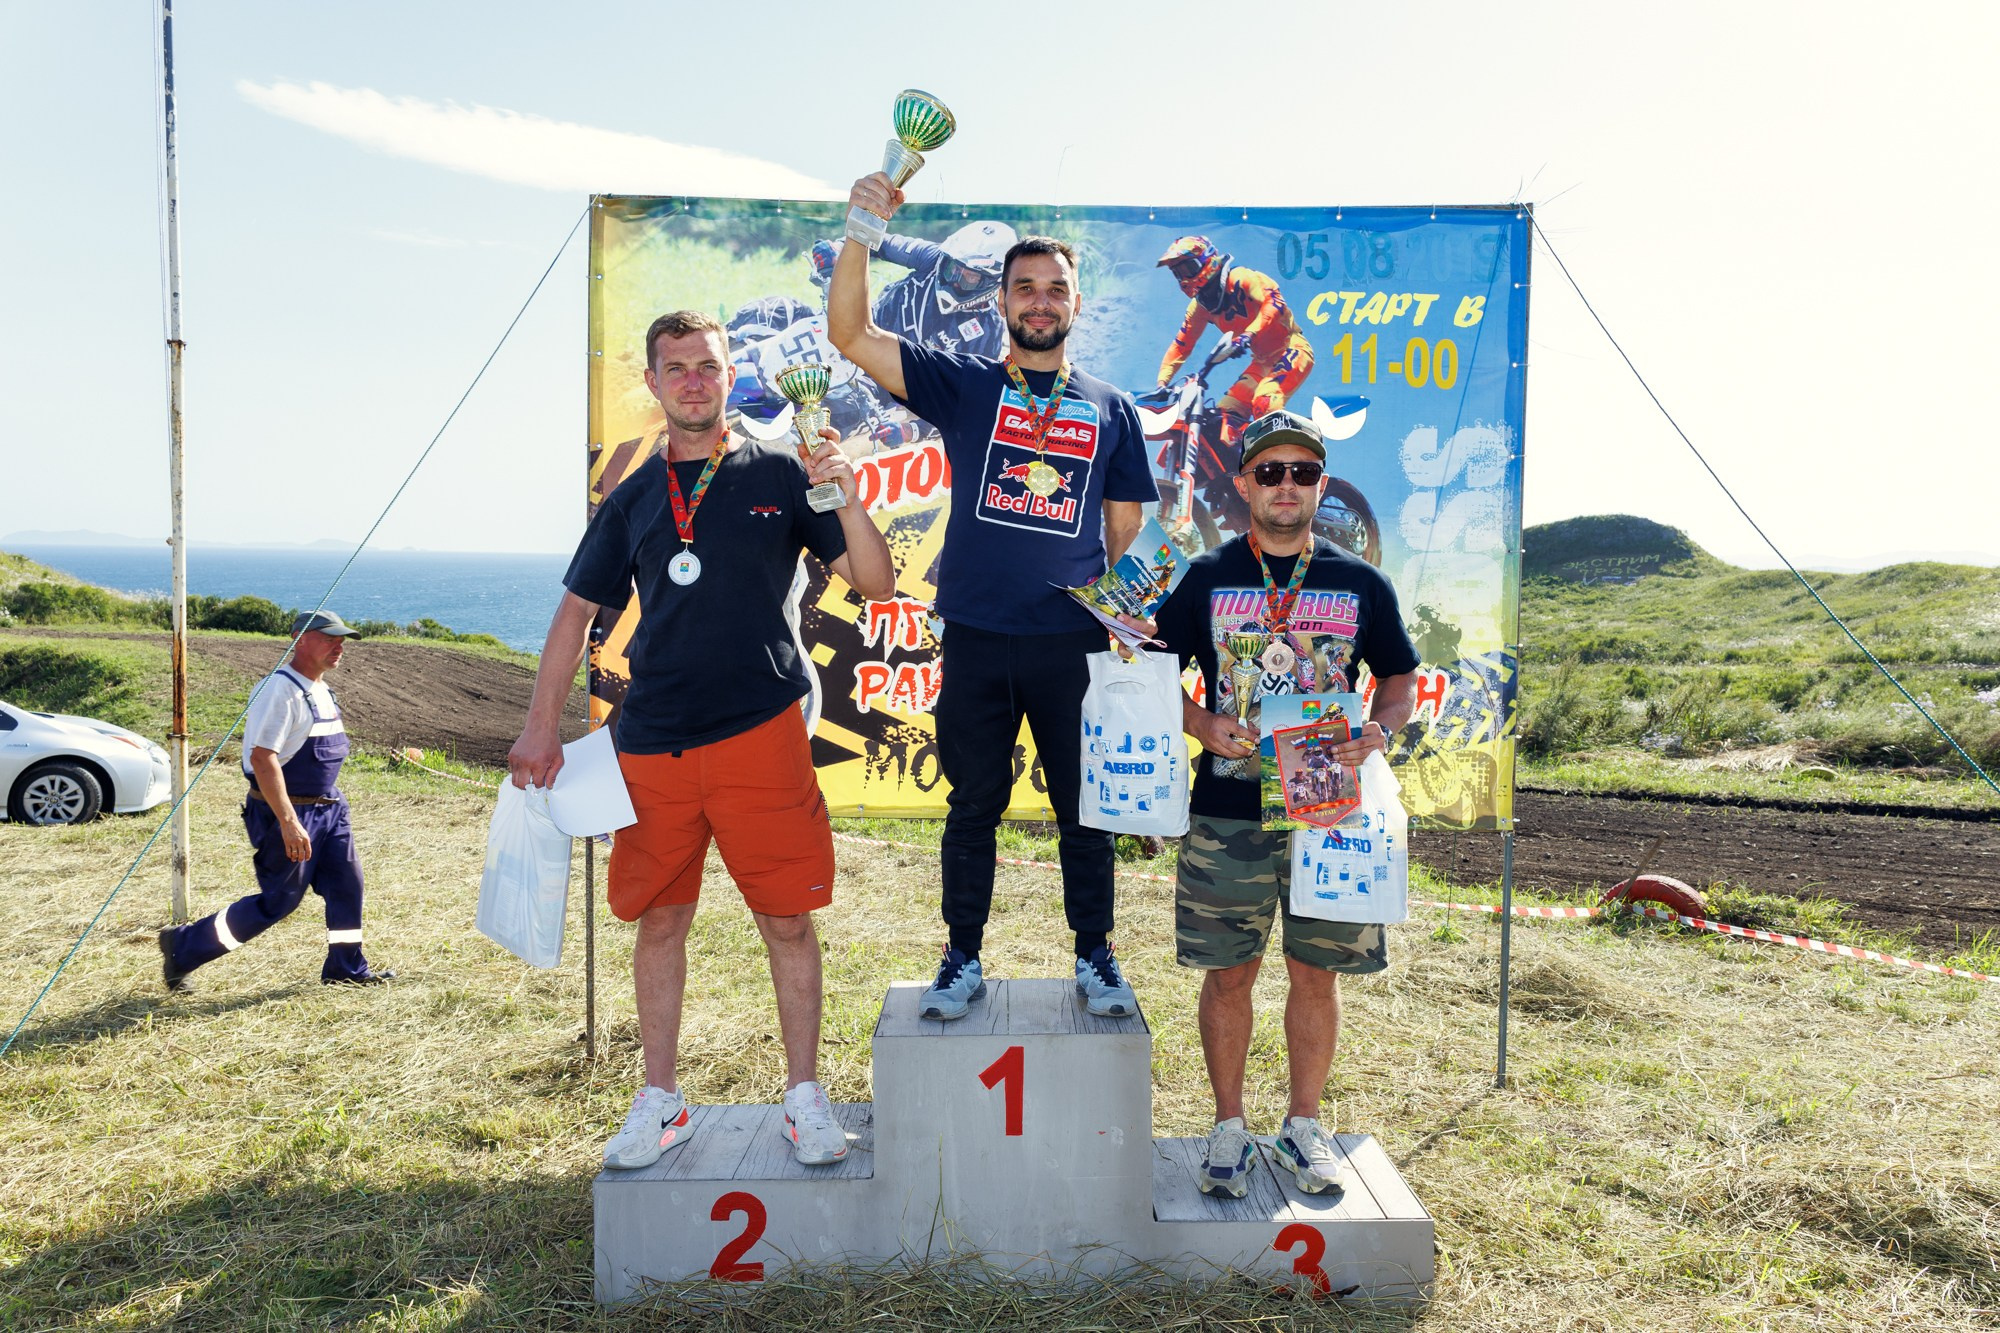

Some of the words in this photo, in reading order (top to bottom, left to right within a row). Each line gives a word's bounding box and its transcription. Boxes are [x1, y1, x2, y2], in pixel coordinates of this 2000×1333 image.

[1276, 231, 1331, 281] 05
[1306, 290, 1441, 327] СТАРТ
[1452, 295, 1487, 328] В
[1332, 333, 1459, 390] 11-00
[1003, 413, 1093, 443] GAGAS
[1047, 438, 1088, 450] RACING
[985, 483, 1031, 514] Red
[1028, 494, 1078, 523] Bull
[1562, 554, 1660, 570] ЭКСТРИМ
[1578, 564, 1641, 577] ТРЭК
[1102, 760, 1155, 775] ABRO
[1321, 835, 1372, 854] ABRO
[978, 1046, 1025, 1136] 1
[709, 1191, 768, 1282] 2
[1272, 1222, 1332, 1301] 3
